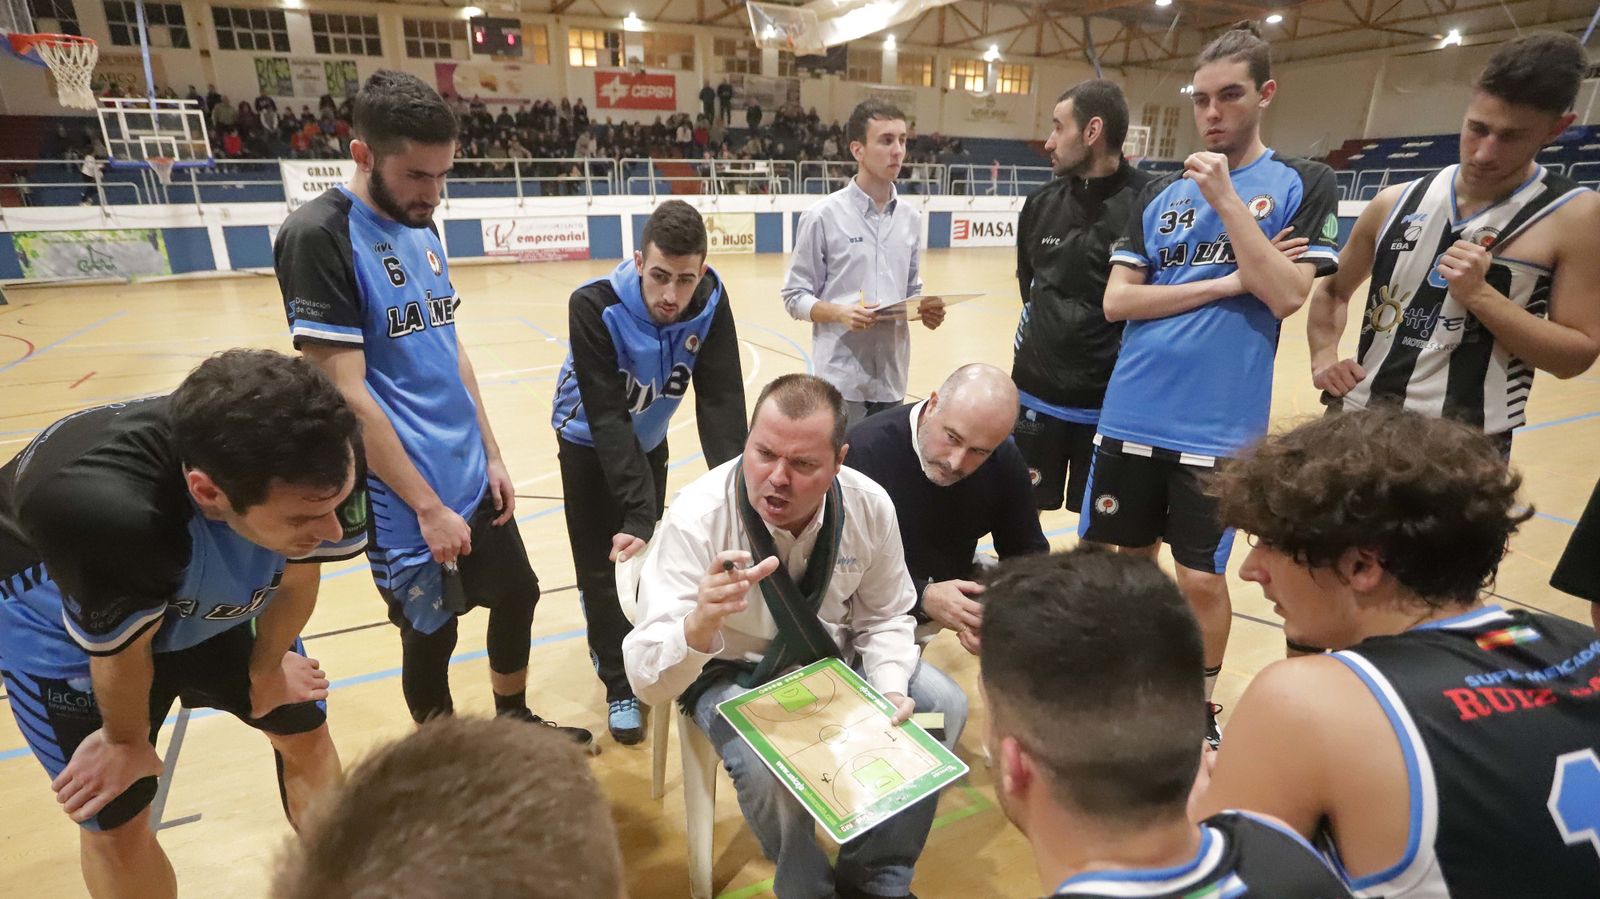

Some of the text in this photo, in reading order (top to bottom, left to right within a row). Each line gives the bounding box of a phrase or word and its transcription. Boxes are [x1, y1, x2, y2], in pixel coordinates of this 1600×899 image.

[631, 84, 673, 99] CEPSA
[307, 167, 342, 177] GRADA
[972, 221, 1014, 237] MASA
[1157, 207, 1196, 236] 34
[517, 230, 586, 244] empresarial
[723, 233, 754, 246] HIJOS
[1041, 235, 1061, 246] vive
[1390, 242, 1409, 250] EBA
[382, 255, 407, 288] 6
[386, 301, 425, 340] LA
[1442, 687, 1556, 721] RUIZ
